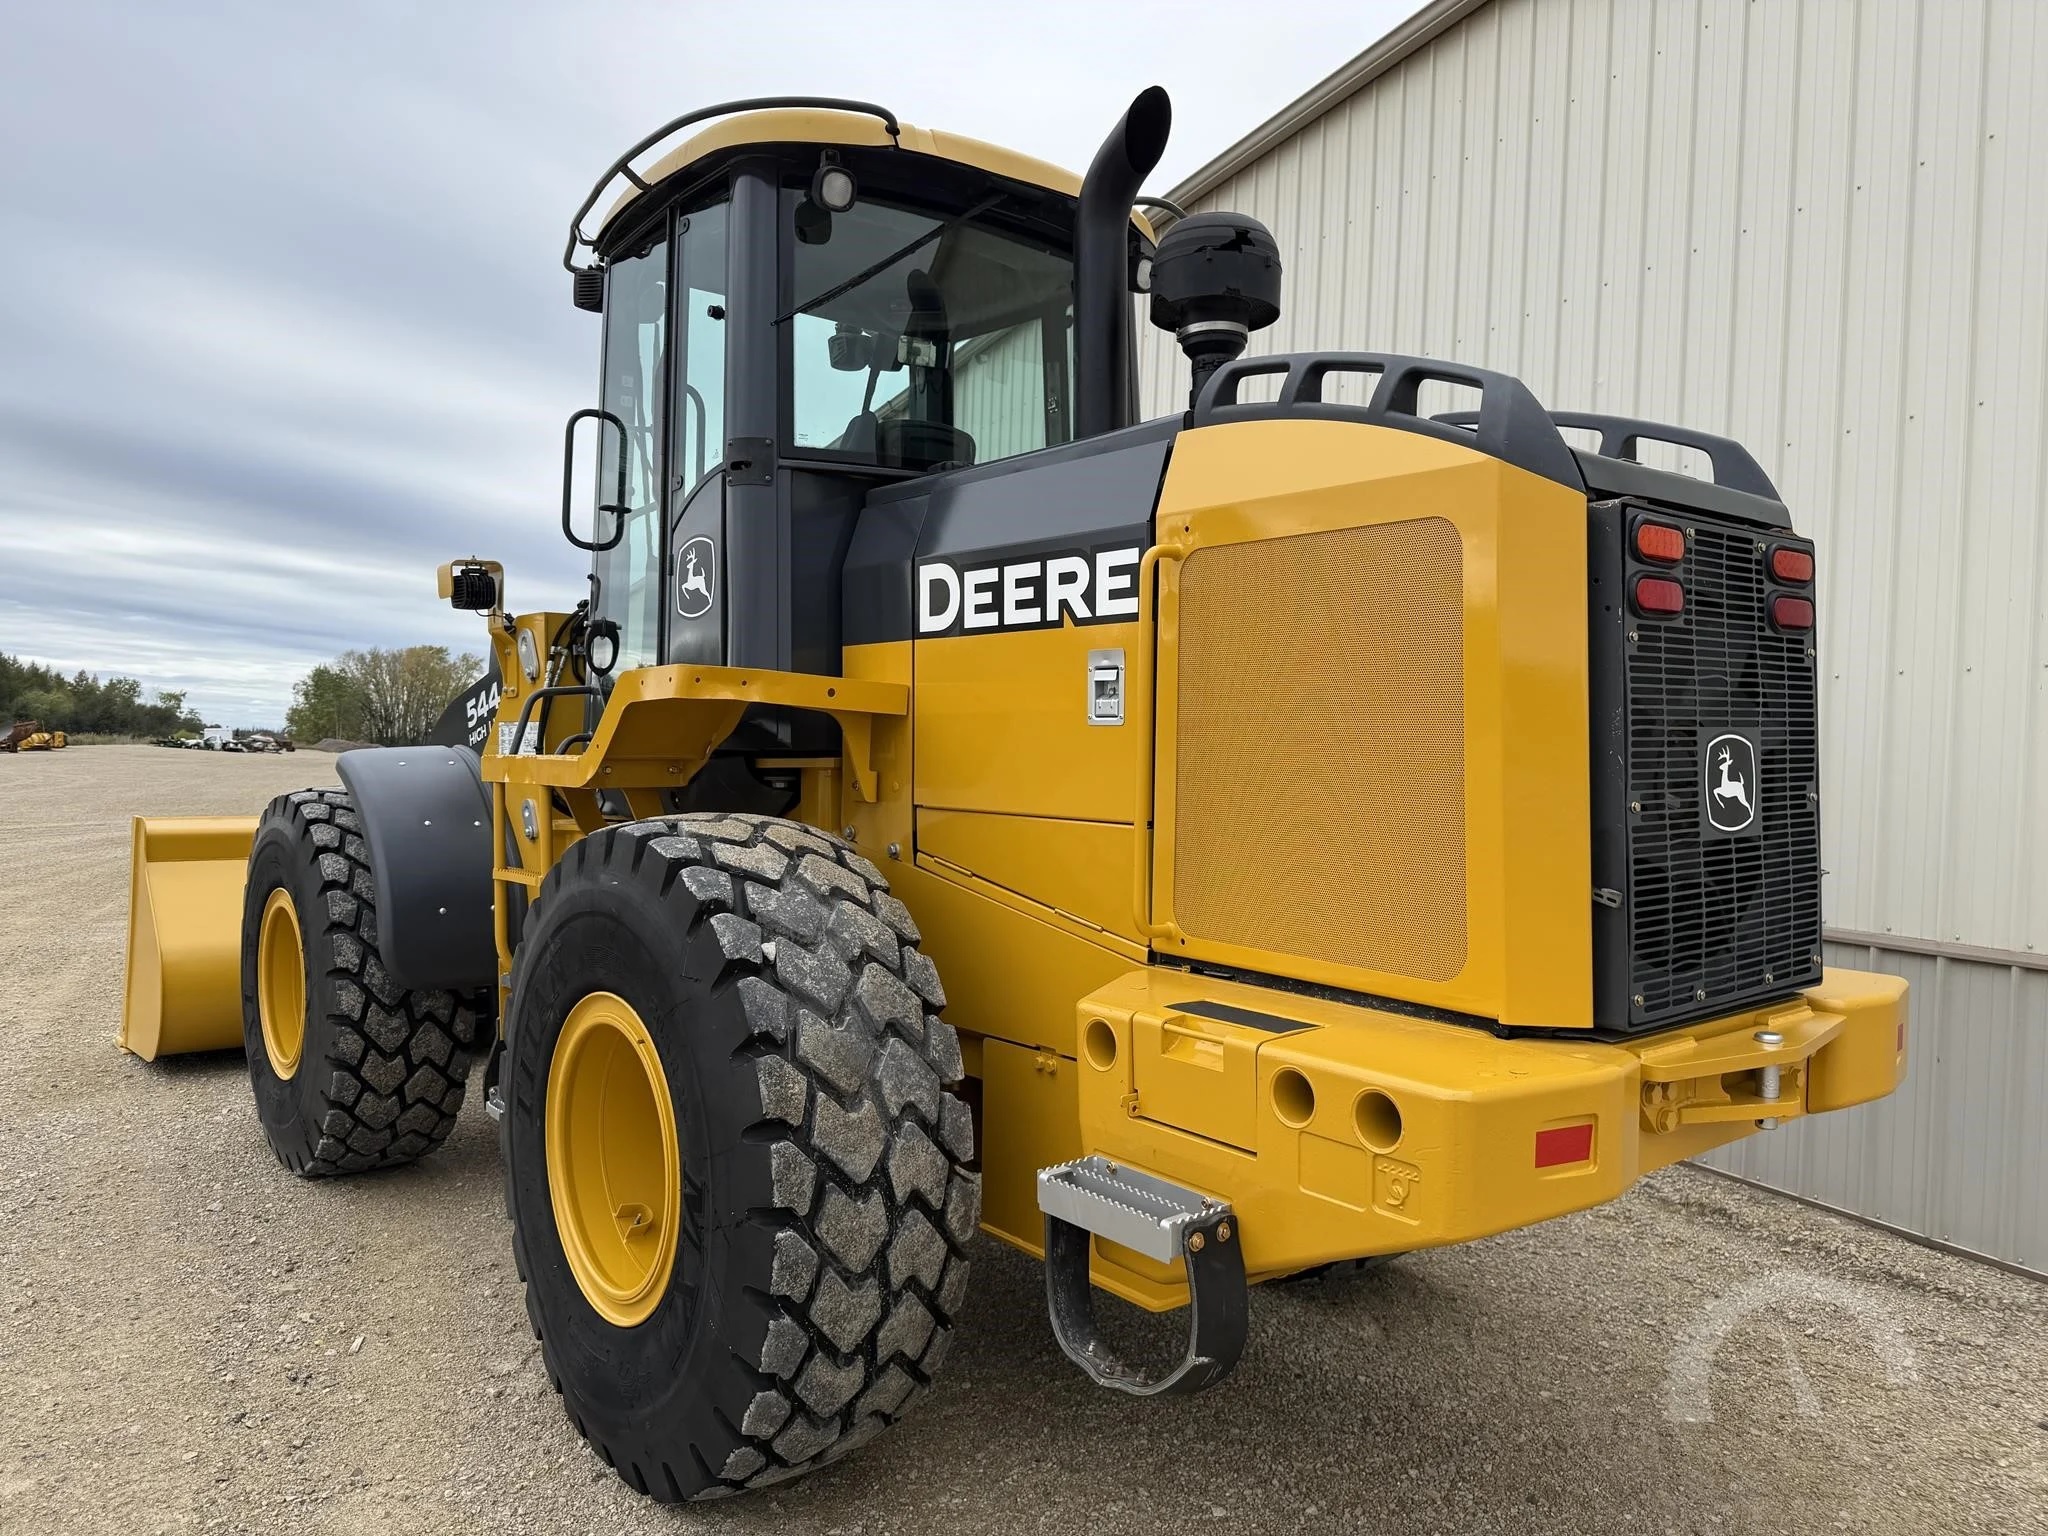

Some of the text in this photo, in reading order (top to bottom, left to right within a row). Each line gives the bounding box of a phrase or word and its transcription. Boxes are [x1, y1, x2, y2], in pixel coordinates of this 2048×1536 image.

[919, 547, 1139, 633] DEERE
[466, 682, 500, 728] 544
[469, 725, 487, 746] HIGH
